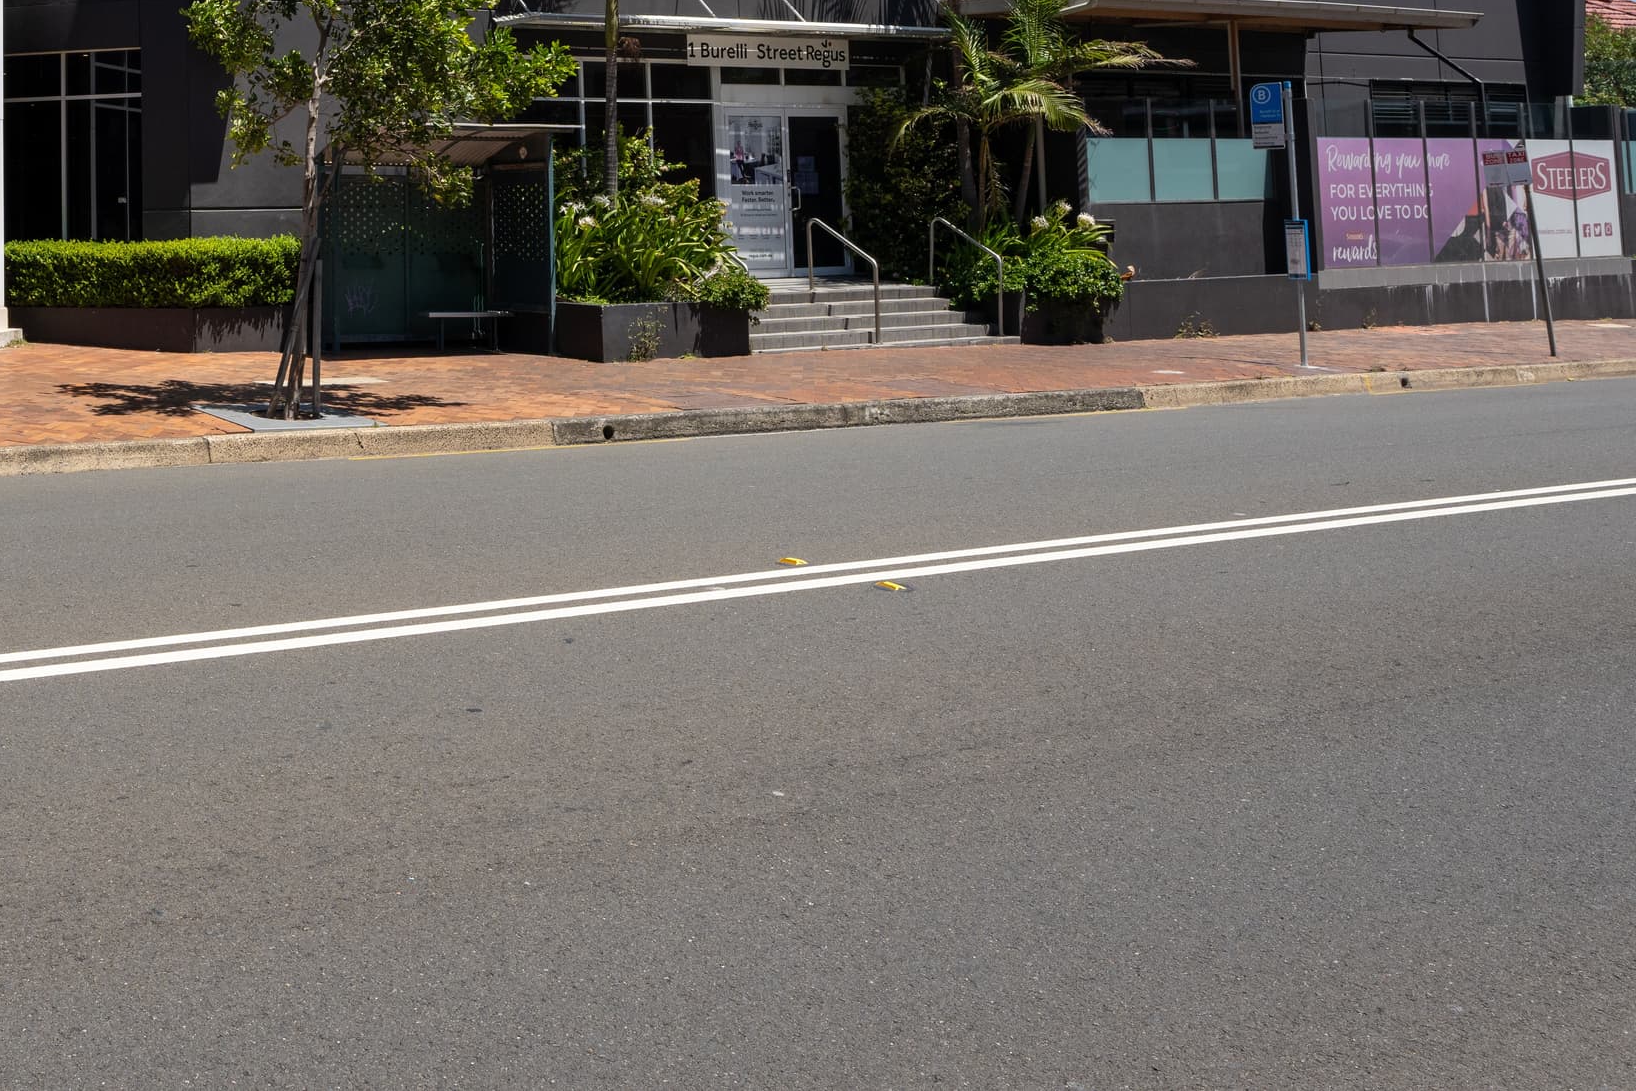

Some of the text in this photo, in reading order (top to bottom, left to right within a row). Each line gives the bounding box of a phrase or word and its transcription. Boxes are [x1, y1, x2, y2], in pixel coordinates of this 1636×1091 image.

[688, 41, 846, 68] 1 Burelli Street Regus
[1257, 89, 1267, 101] B
[1395, 152, 1422, 179] you
[1537, 162, 1606, 191] STEELERS
[1330, 184, 1355, 198] FOR
[1331, 206, 1357, 221] YOU
[1360, 205, 1392, 221] LOVE
[1395, 205, 1411, 219] TO
[1333, 234, 1378, 262] rewards
